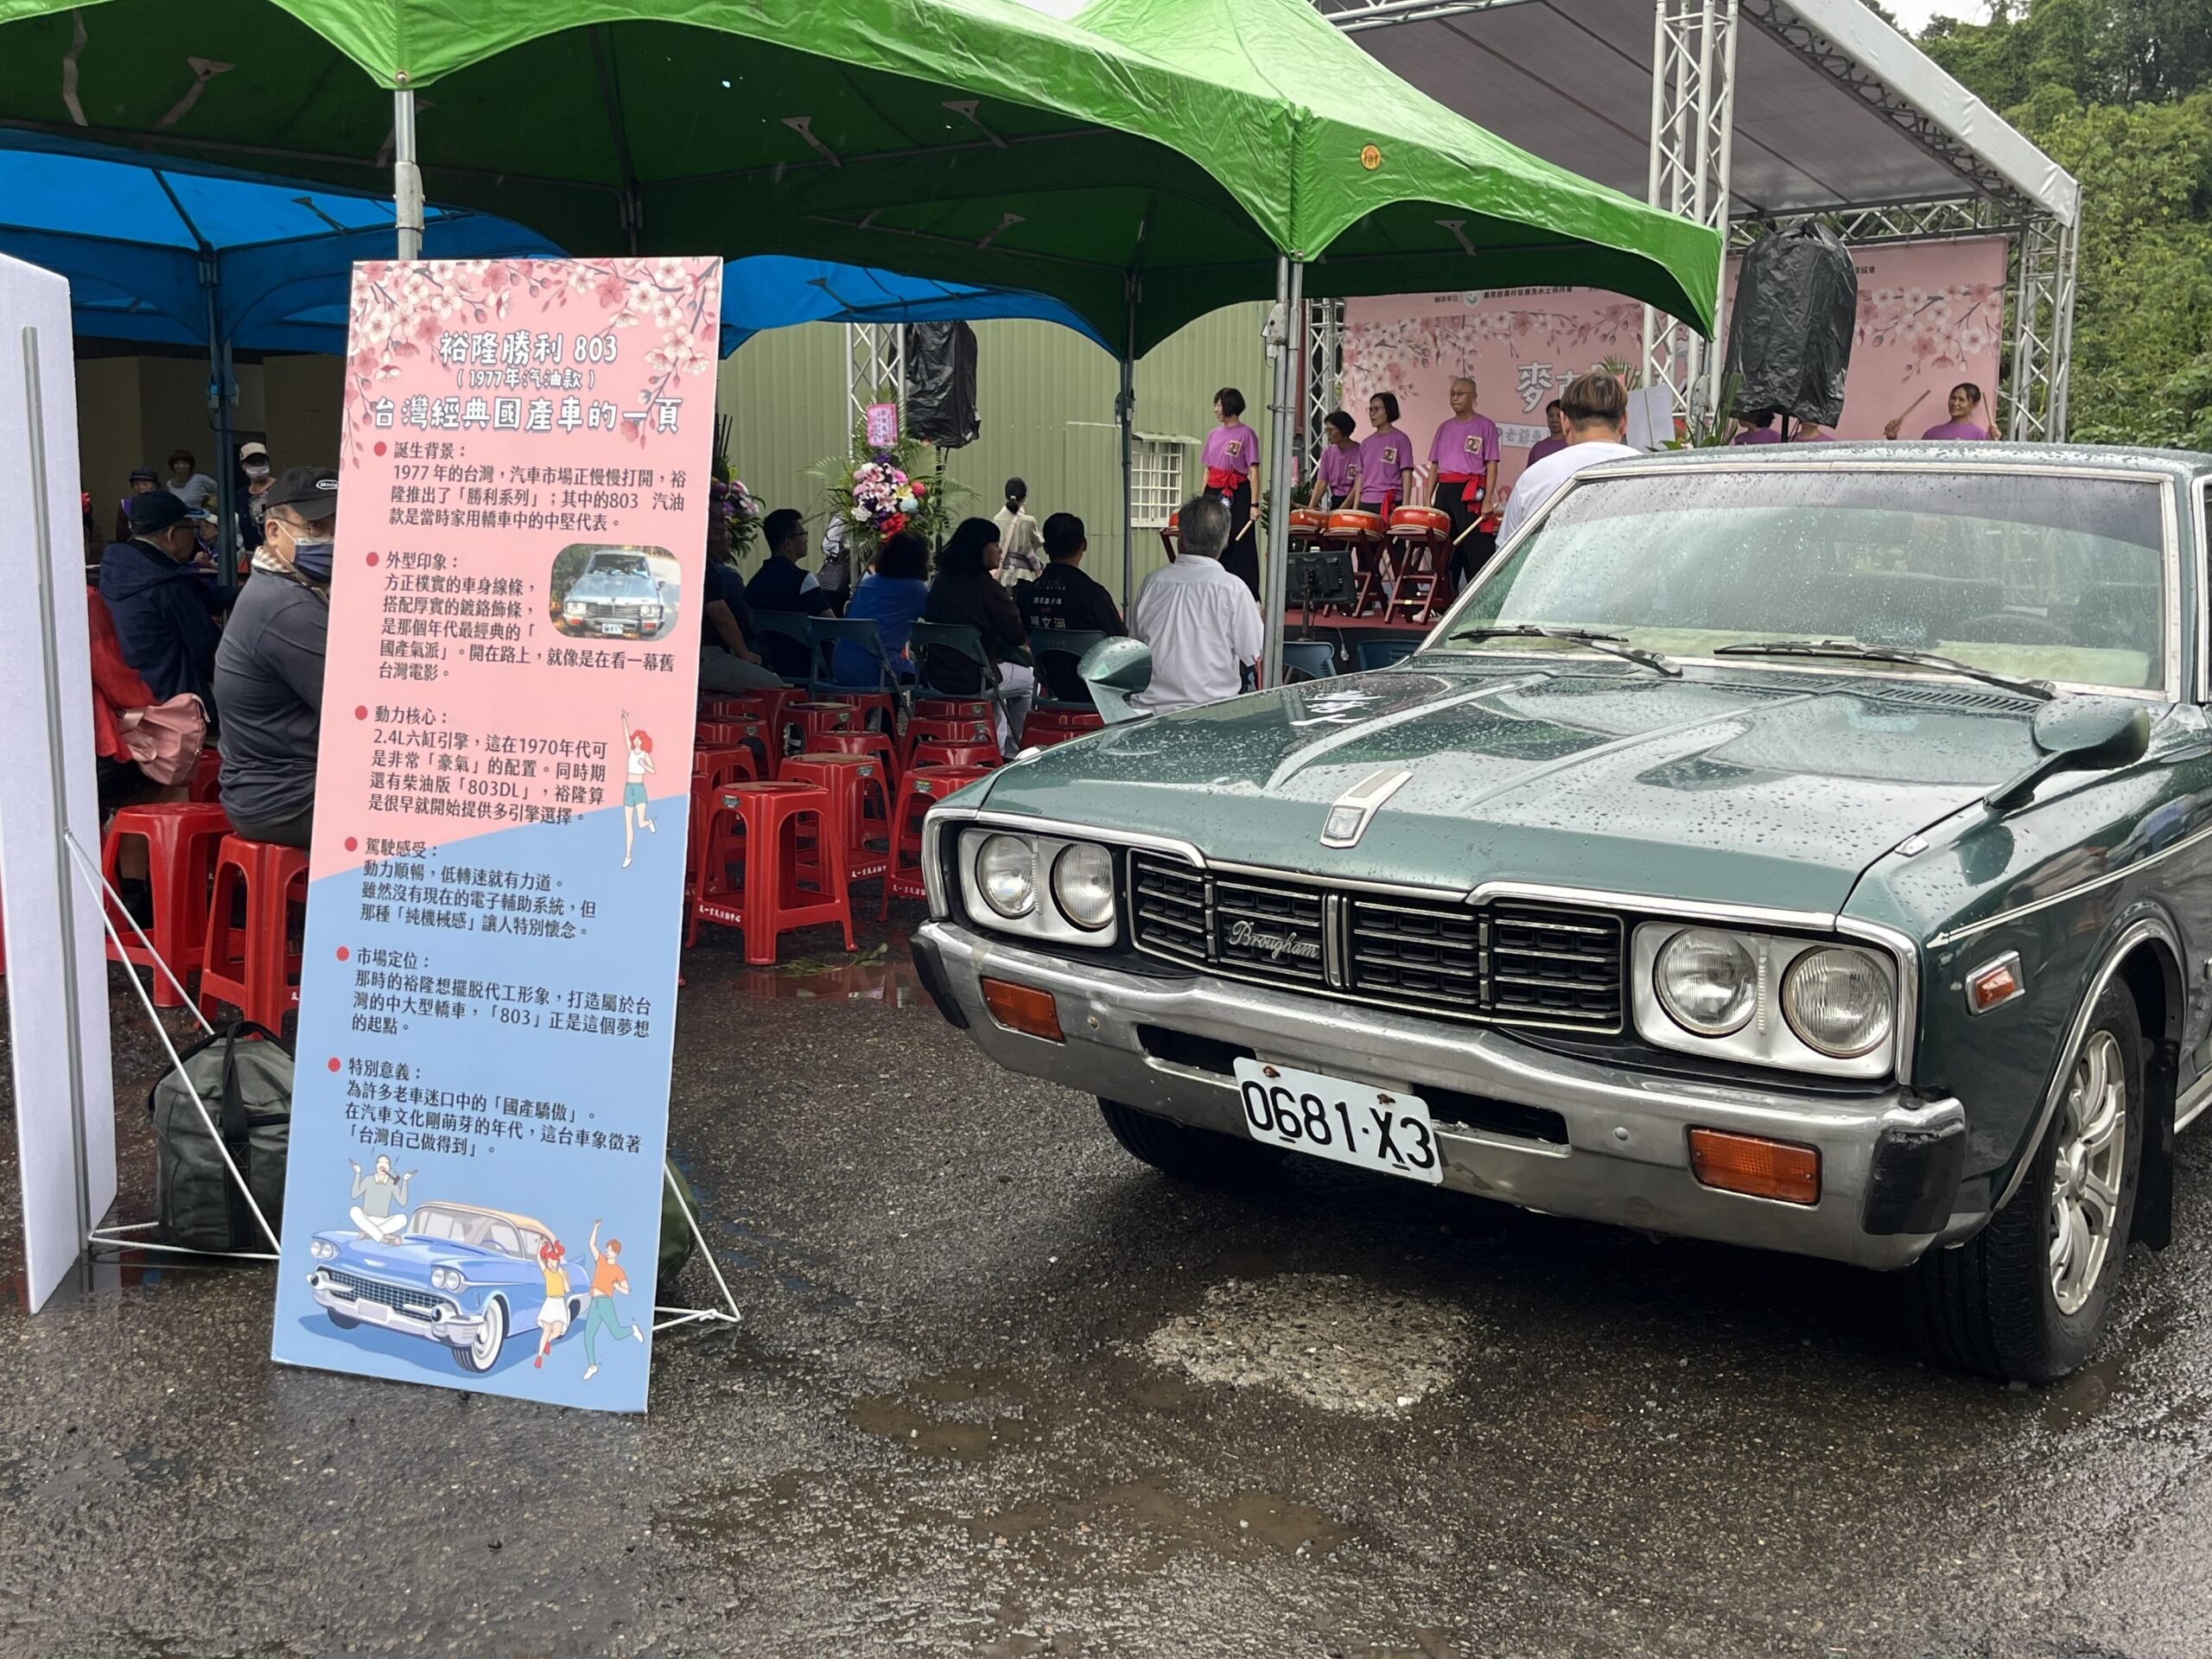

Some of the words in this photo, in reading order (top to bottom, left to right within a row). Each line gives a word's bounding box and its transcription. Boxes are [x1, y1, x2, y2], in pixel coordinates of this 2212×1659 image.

[440, 330, 564, 366] 裕隆勝利
[573, 334, 618, 363] 803
[373, 394, 683, 433] 台灣經典國產車的一頁
[389, 506, 620, 532] 款是當時家用轎車中的中堅代表。
[379, 661, 449, 681] 台灣電影。
[368, 793, 585, 825] 是很早就開始提供多引擎選擇。
[1229, 920, 1320, 960] Brougham
[352, 1014, 409, 1035] 的起點。
